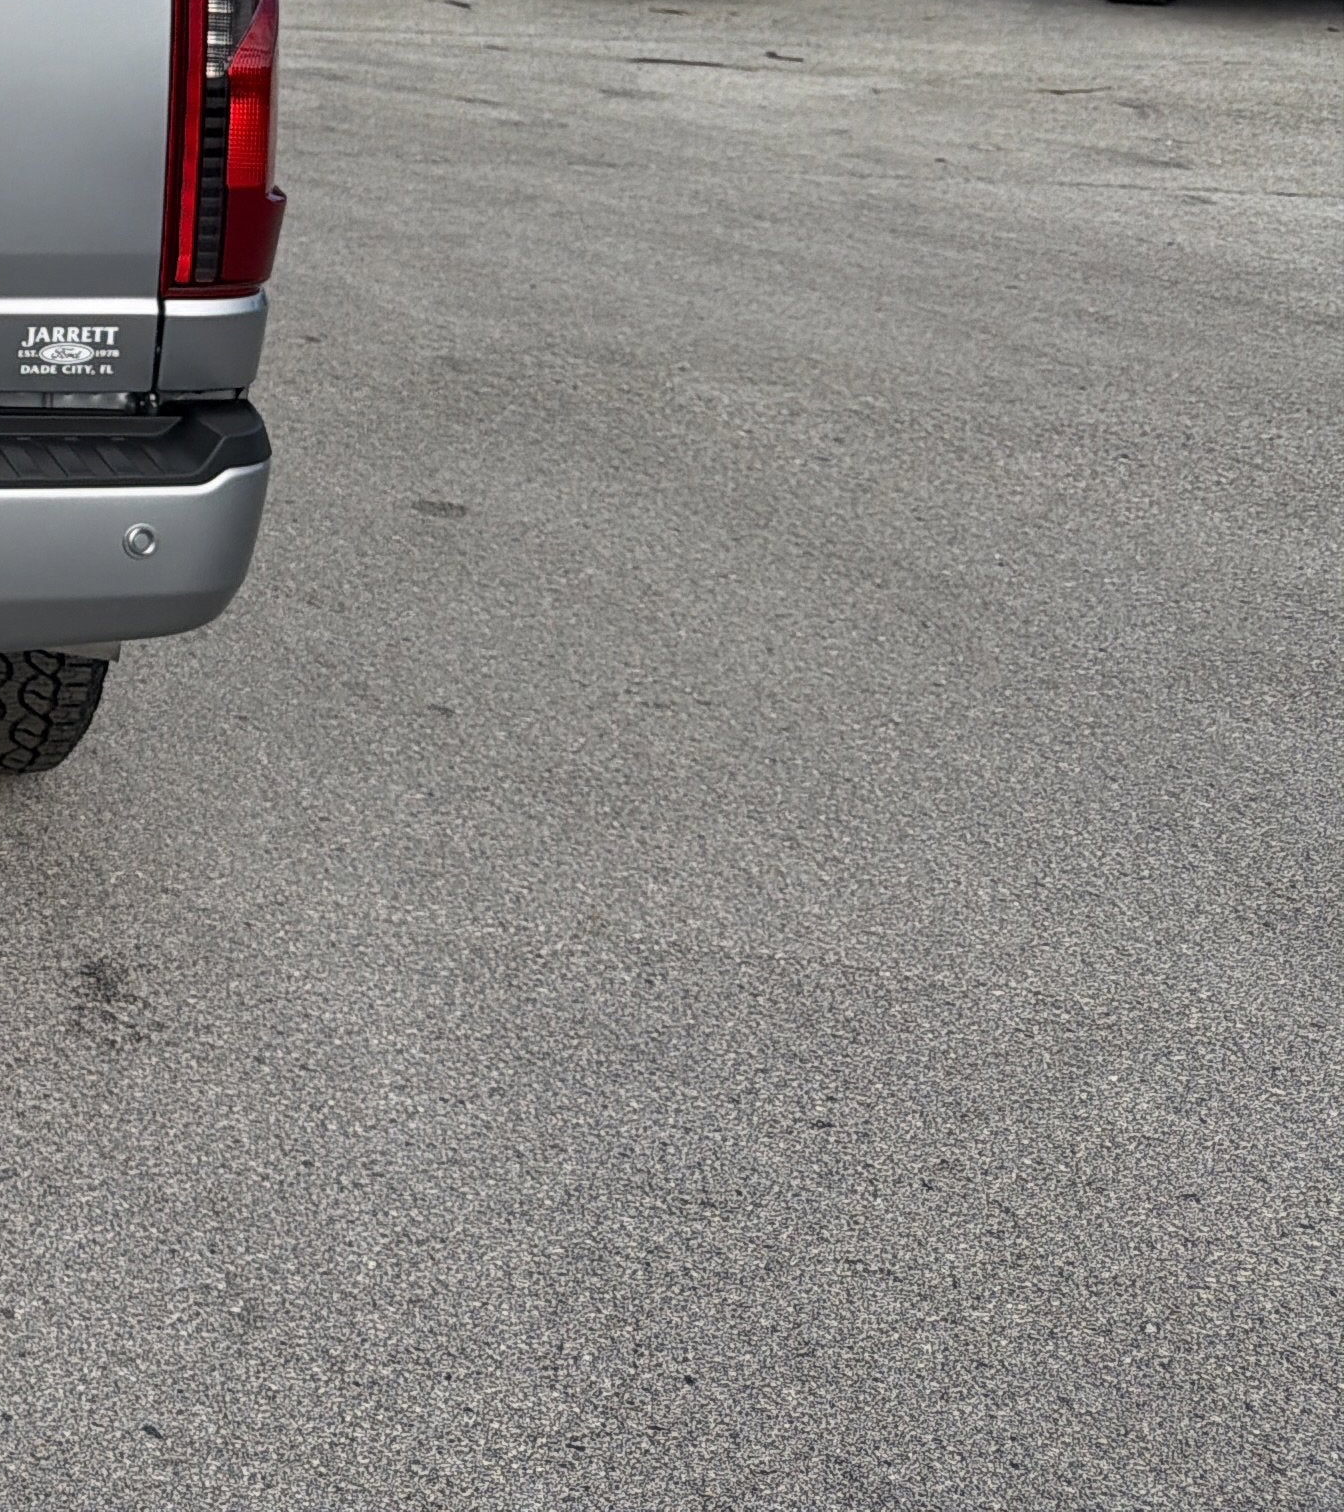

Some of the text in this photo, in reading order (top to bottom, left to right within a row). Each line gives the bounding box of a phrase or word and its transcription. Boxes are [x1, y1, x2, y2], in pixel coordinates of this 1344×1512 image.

[21, 326, 120, 348] JARRETT
[20, 364, 58, 374] DADE
[99, 364, 114, 374] FL
